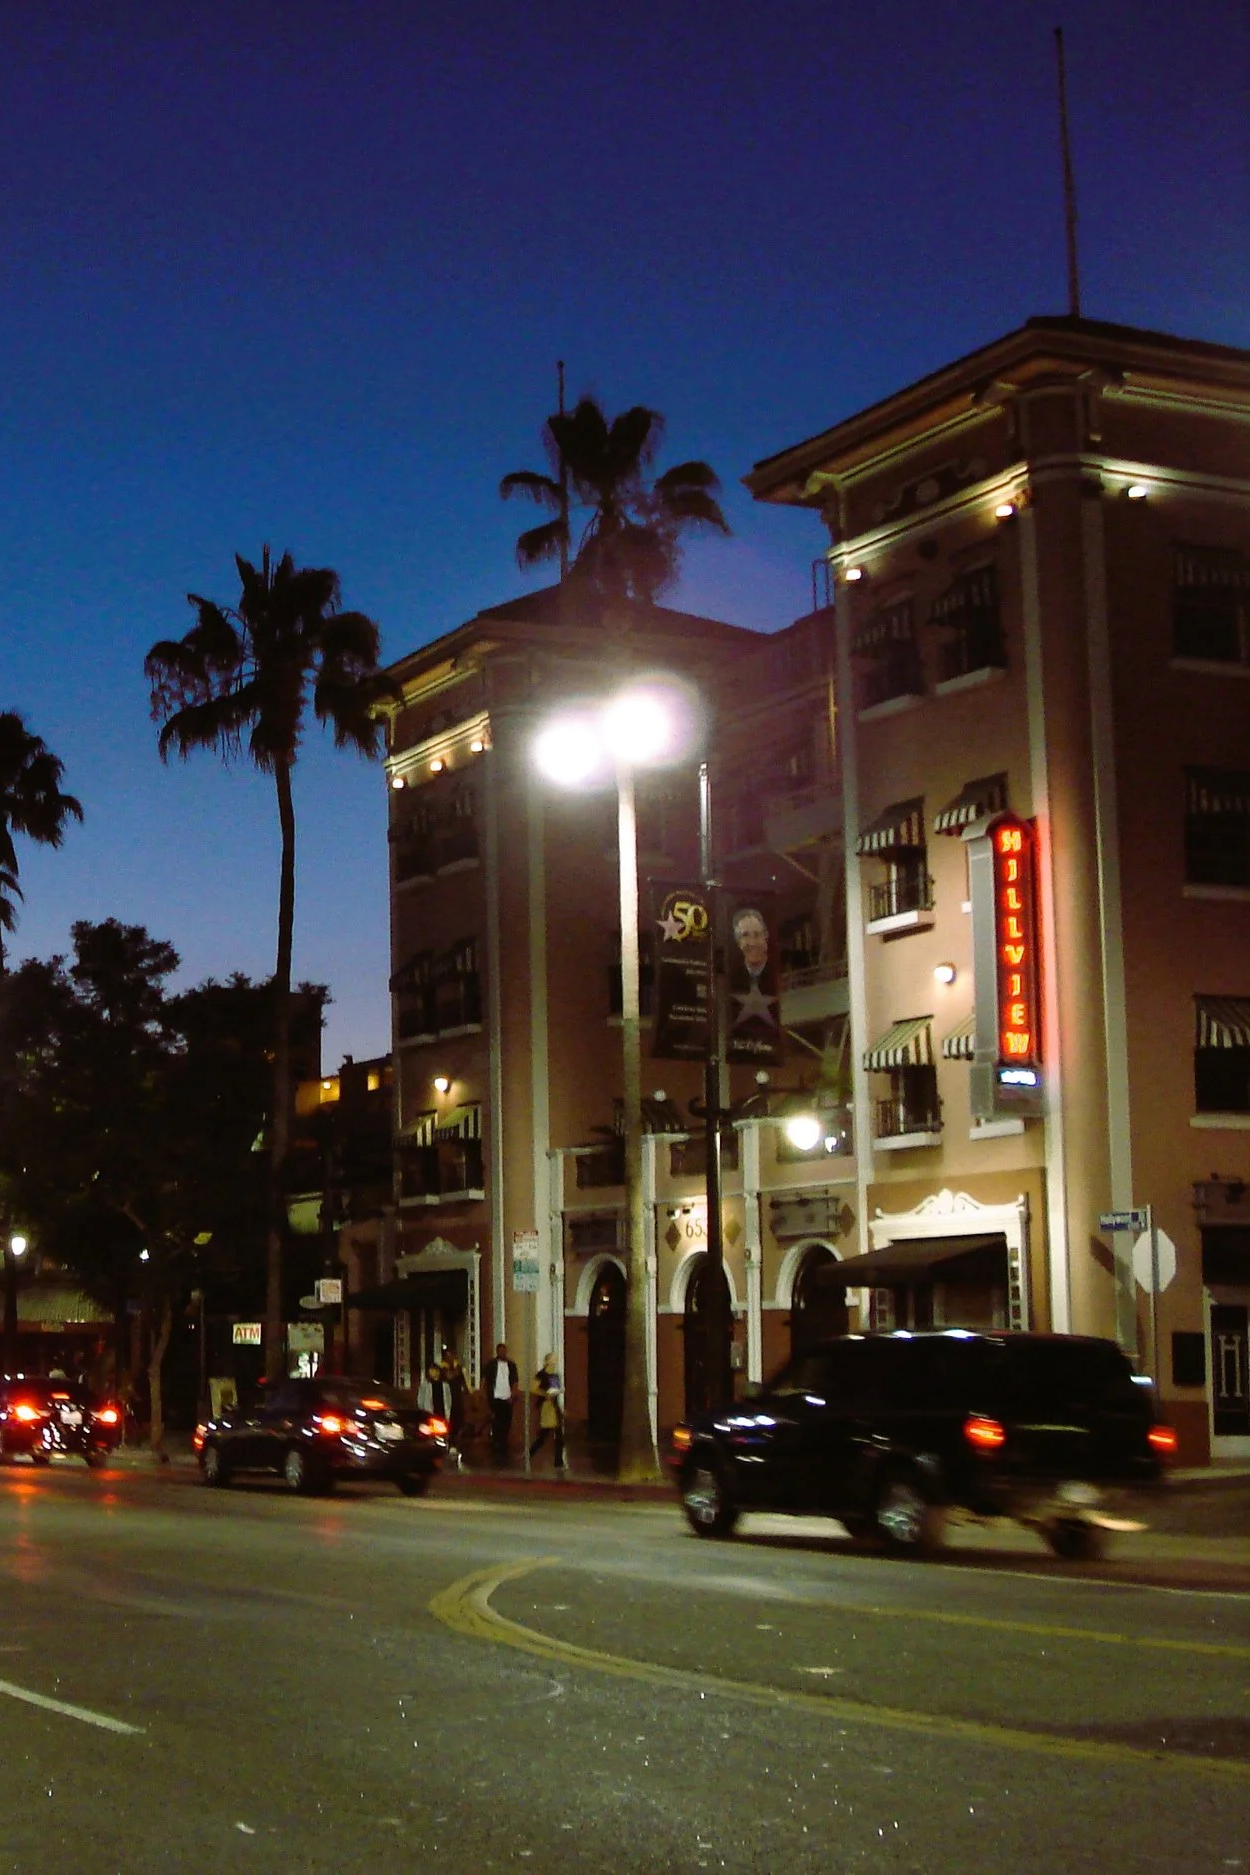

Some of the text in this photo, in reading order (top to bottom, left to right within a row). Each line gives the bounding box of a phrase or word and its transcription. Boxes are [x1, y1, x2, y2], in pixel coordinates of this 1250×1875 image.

[673, 901, 707, 942] 50
[1000, 830, 1029, 1054] HILLVIEW
[234, 1326, 260, 1339] ATM
